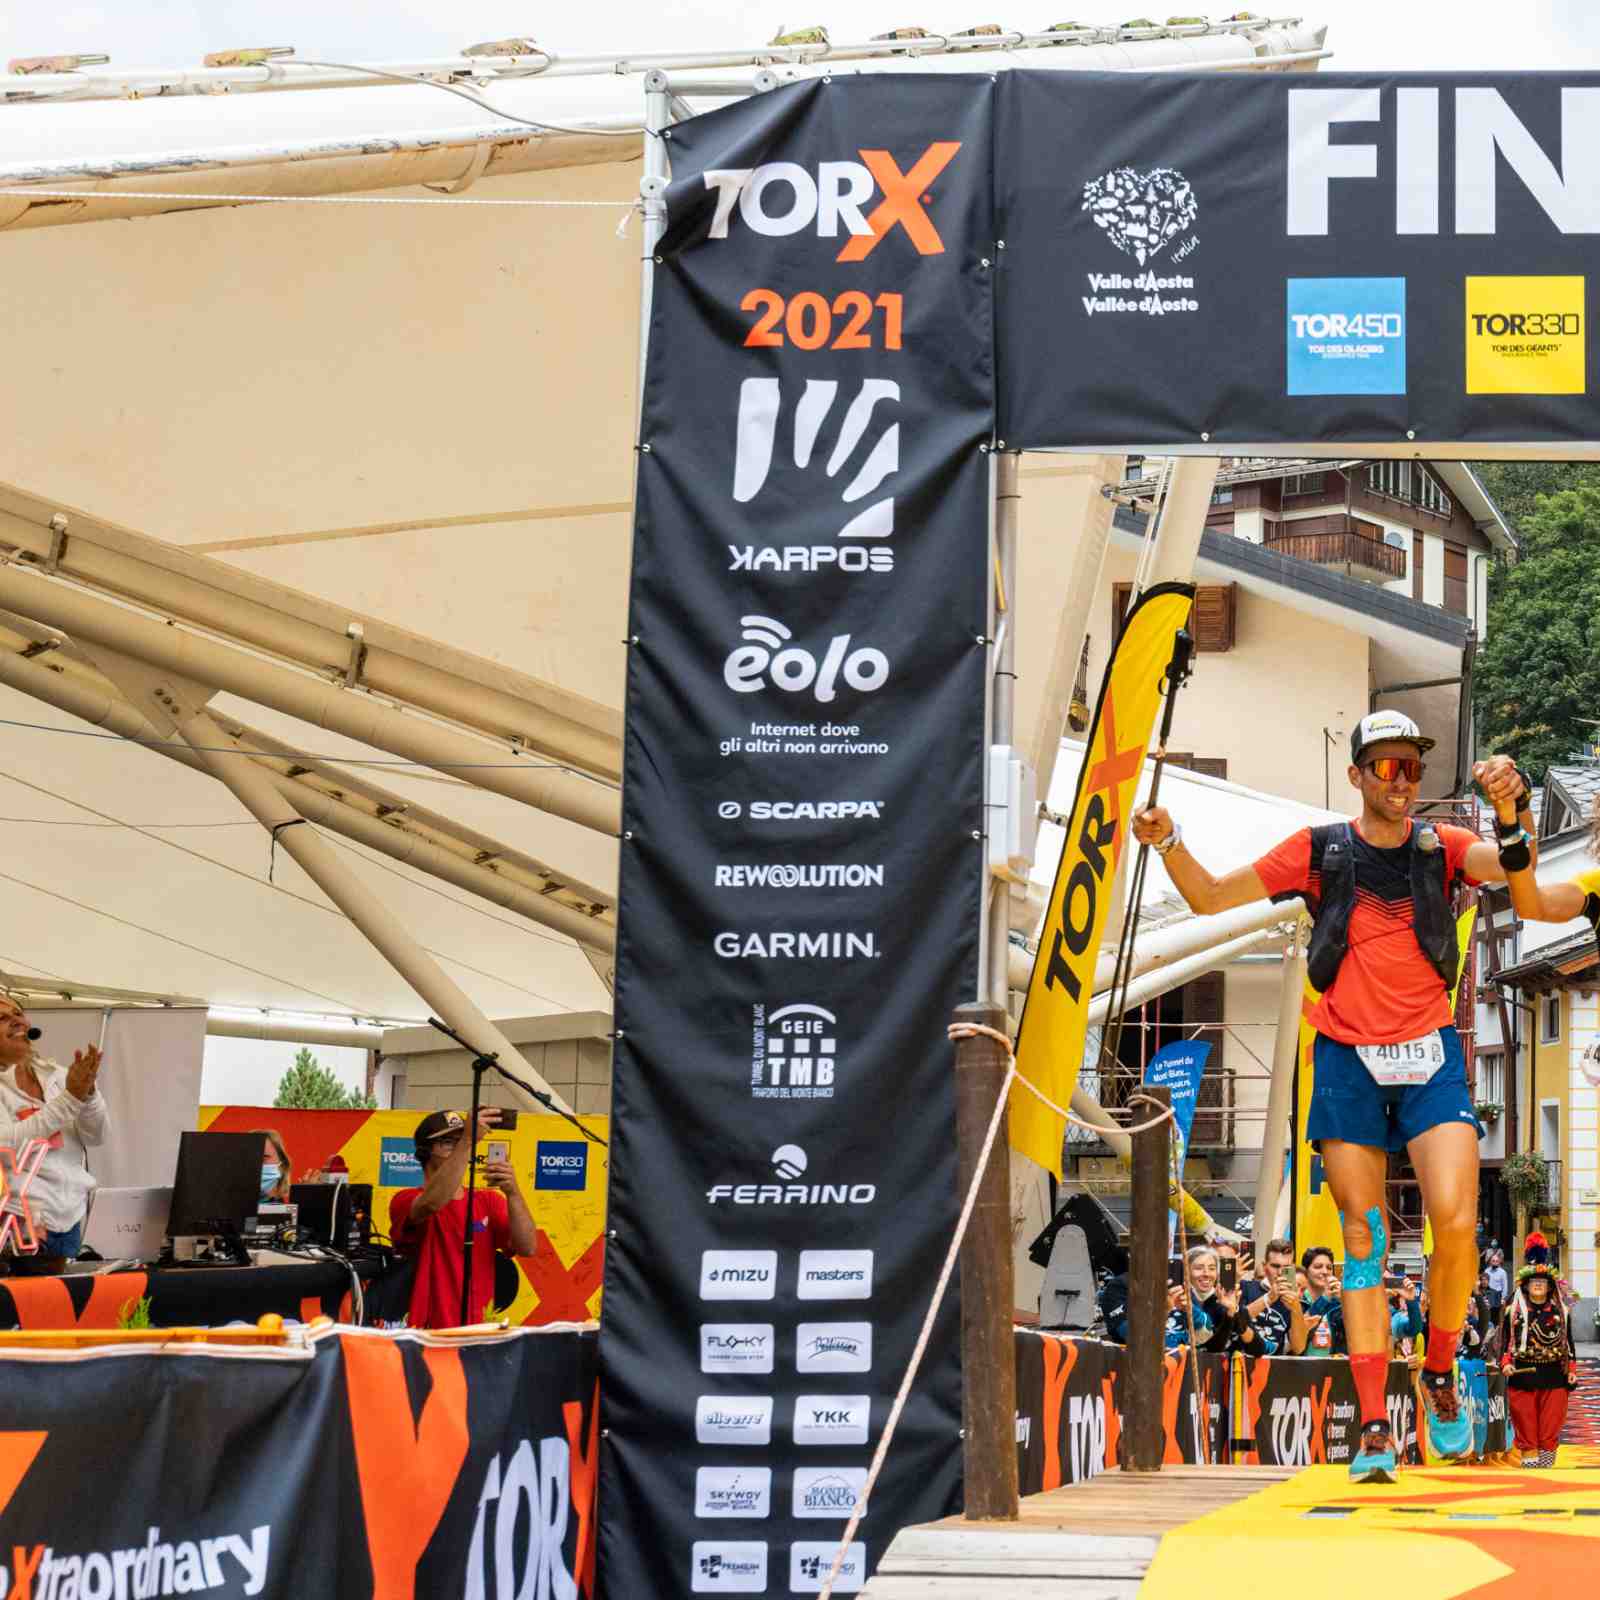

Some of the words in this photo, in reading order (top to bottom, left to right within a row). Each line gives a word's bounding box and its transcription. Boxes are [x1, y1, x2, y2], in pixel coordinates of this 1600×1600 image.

[705, 141, 961, 263] TORX
[1087, 272, 1132, 293] Valle
[1082, 296, 1137, 317] Vallée
[740, 289, 902, 350] 2021
[1291, 313, 1402, 338] TOR450
[1471, 313, 1580, 336] TOR330
[728, 545, 894, 572] KARPOS
[724, 634, 889, 702] eolo
[751, 722, 816, 736] Internet
[820, 722, 859, 736] dove
[720, 738, 741, 756] gli
[745, 738, 780, 753] altri
[784, 743, 815, 753] non
[819, 740, 889, 754] arrivano
[750, 801, 881, 819] SCARPA
[1045, 687, 1145, 1005] TORX
[782, 1020, 823, 1034] GEIE
[1377, 1043, 1425, 1060] 4015
[768, 1057, 834, 1085] TMB
[540, 1155, 585, 1168] TOR130
[706, 1184, 876, 1204] FERRINO
[806, 1269, 864, 1281] masters
[812, 1411, 850, 1423] YKK
[1270, 1376, 1331, 1465] TORX
[804, 1495, 857, 1506] BIANCO
[811, 1487, 850, 1496] MONTE
